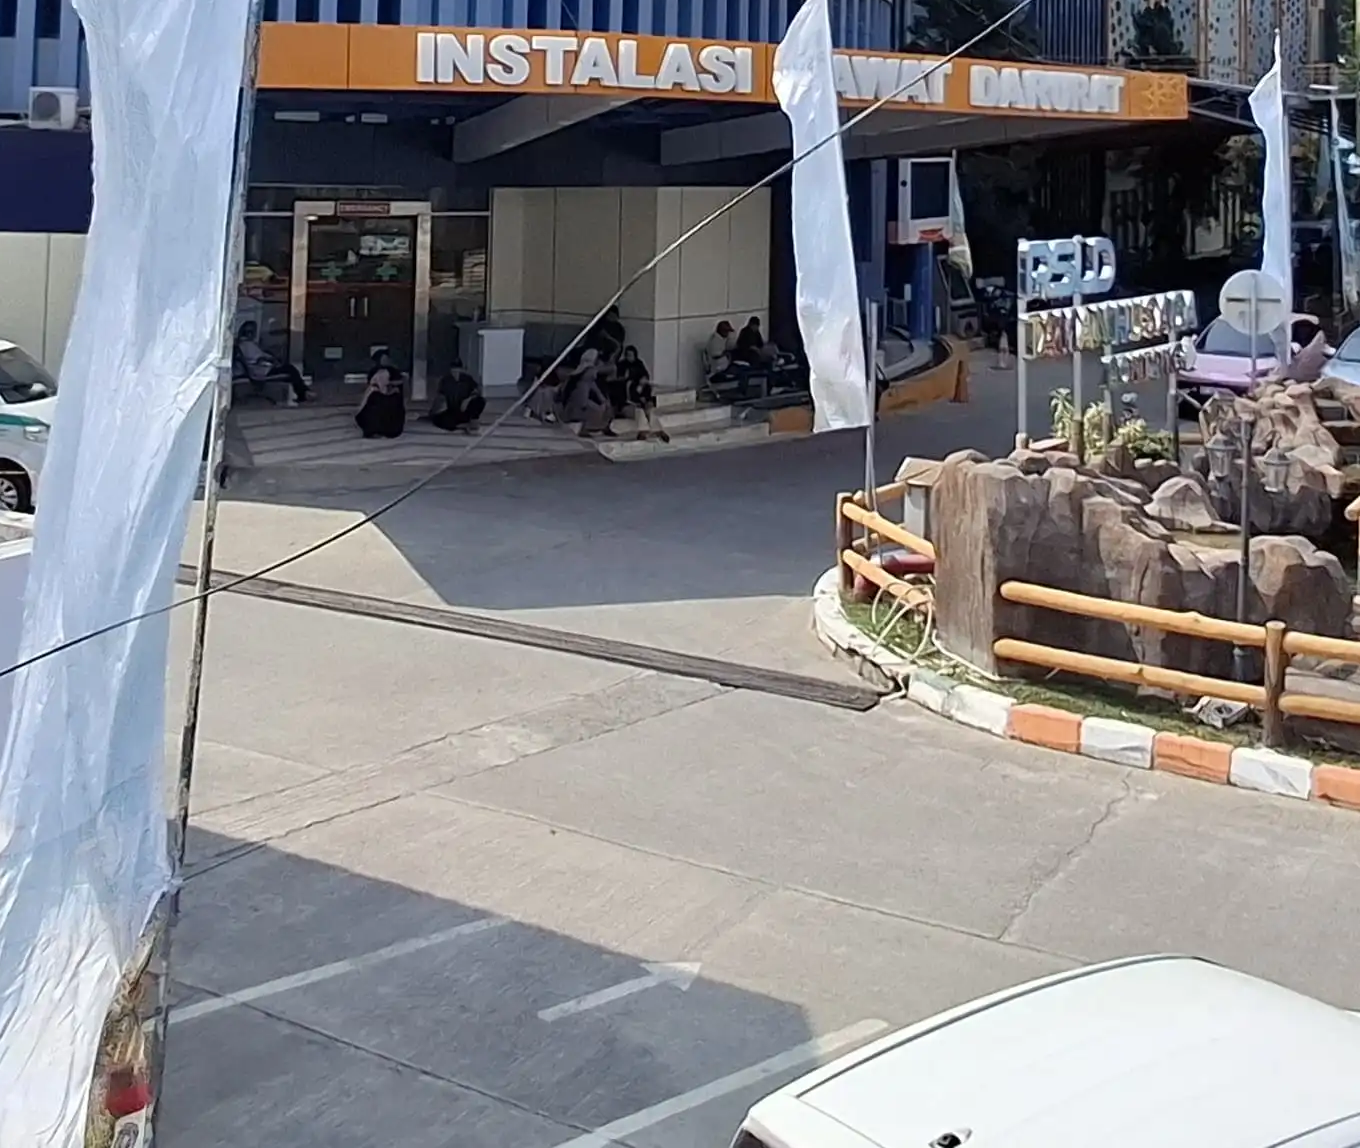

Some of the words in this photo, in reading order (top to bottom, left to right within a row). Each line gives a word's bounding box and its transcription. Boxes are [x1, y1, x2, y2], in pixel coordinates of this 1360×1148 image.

[415, 31, 753, 94] INSTALASI
[832, 54, 953, 104] AWAT
[969, 64, 1125, 113] DARURAT
